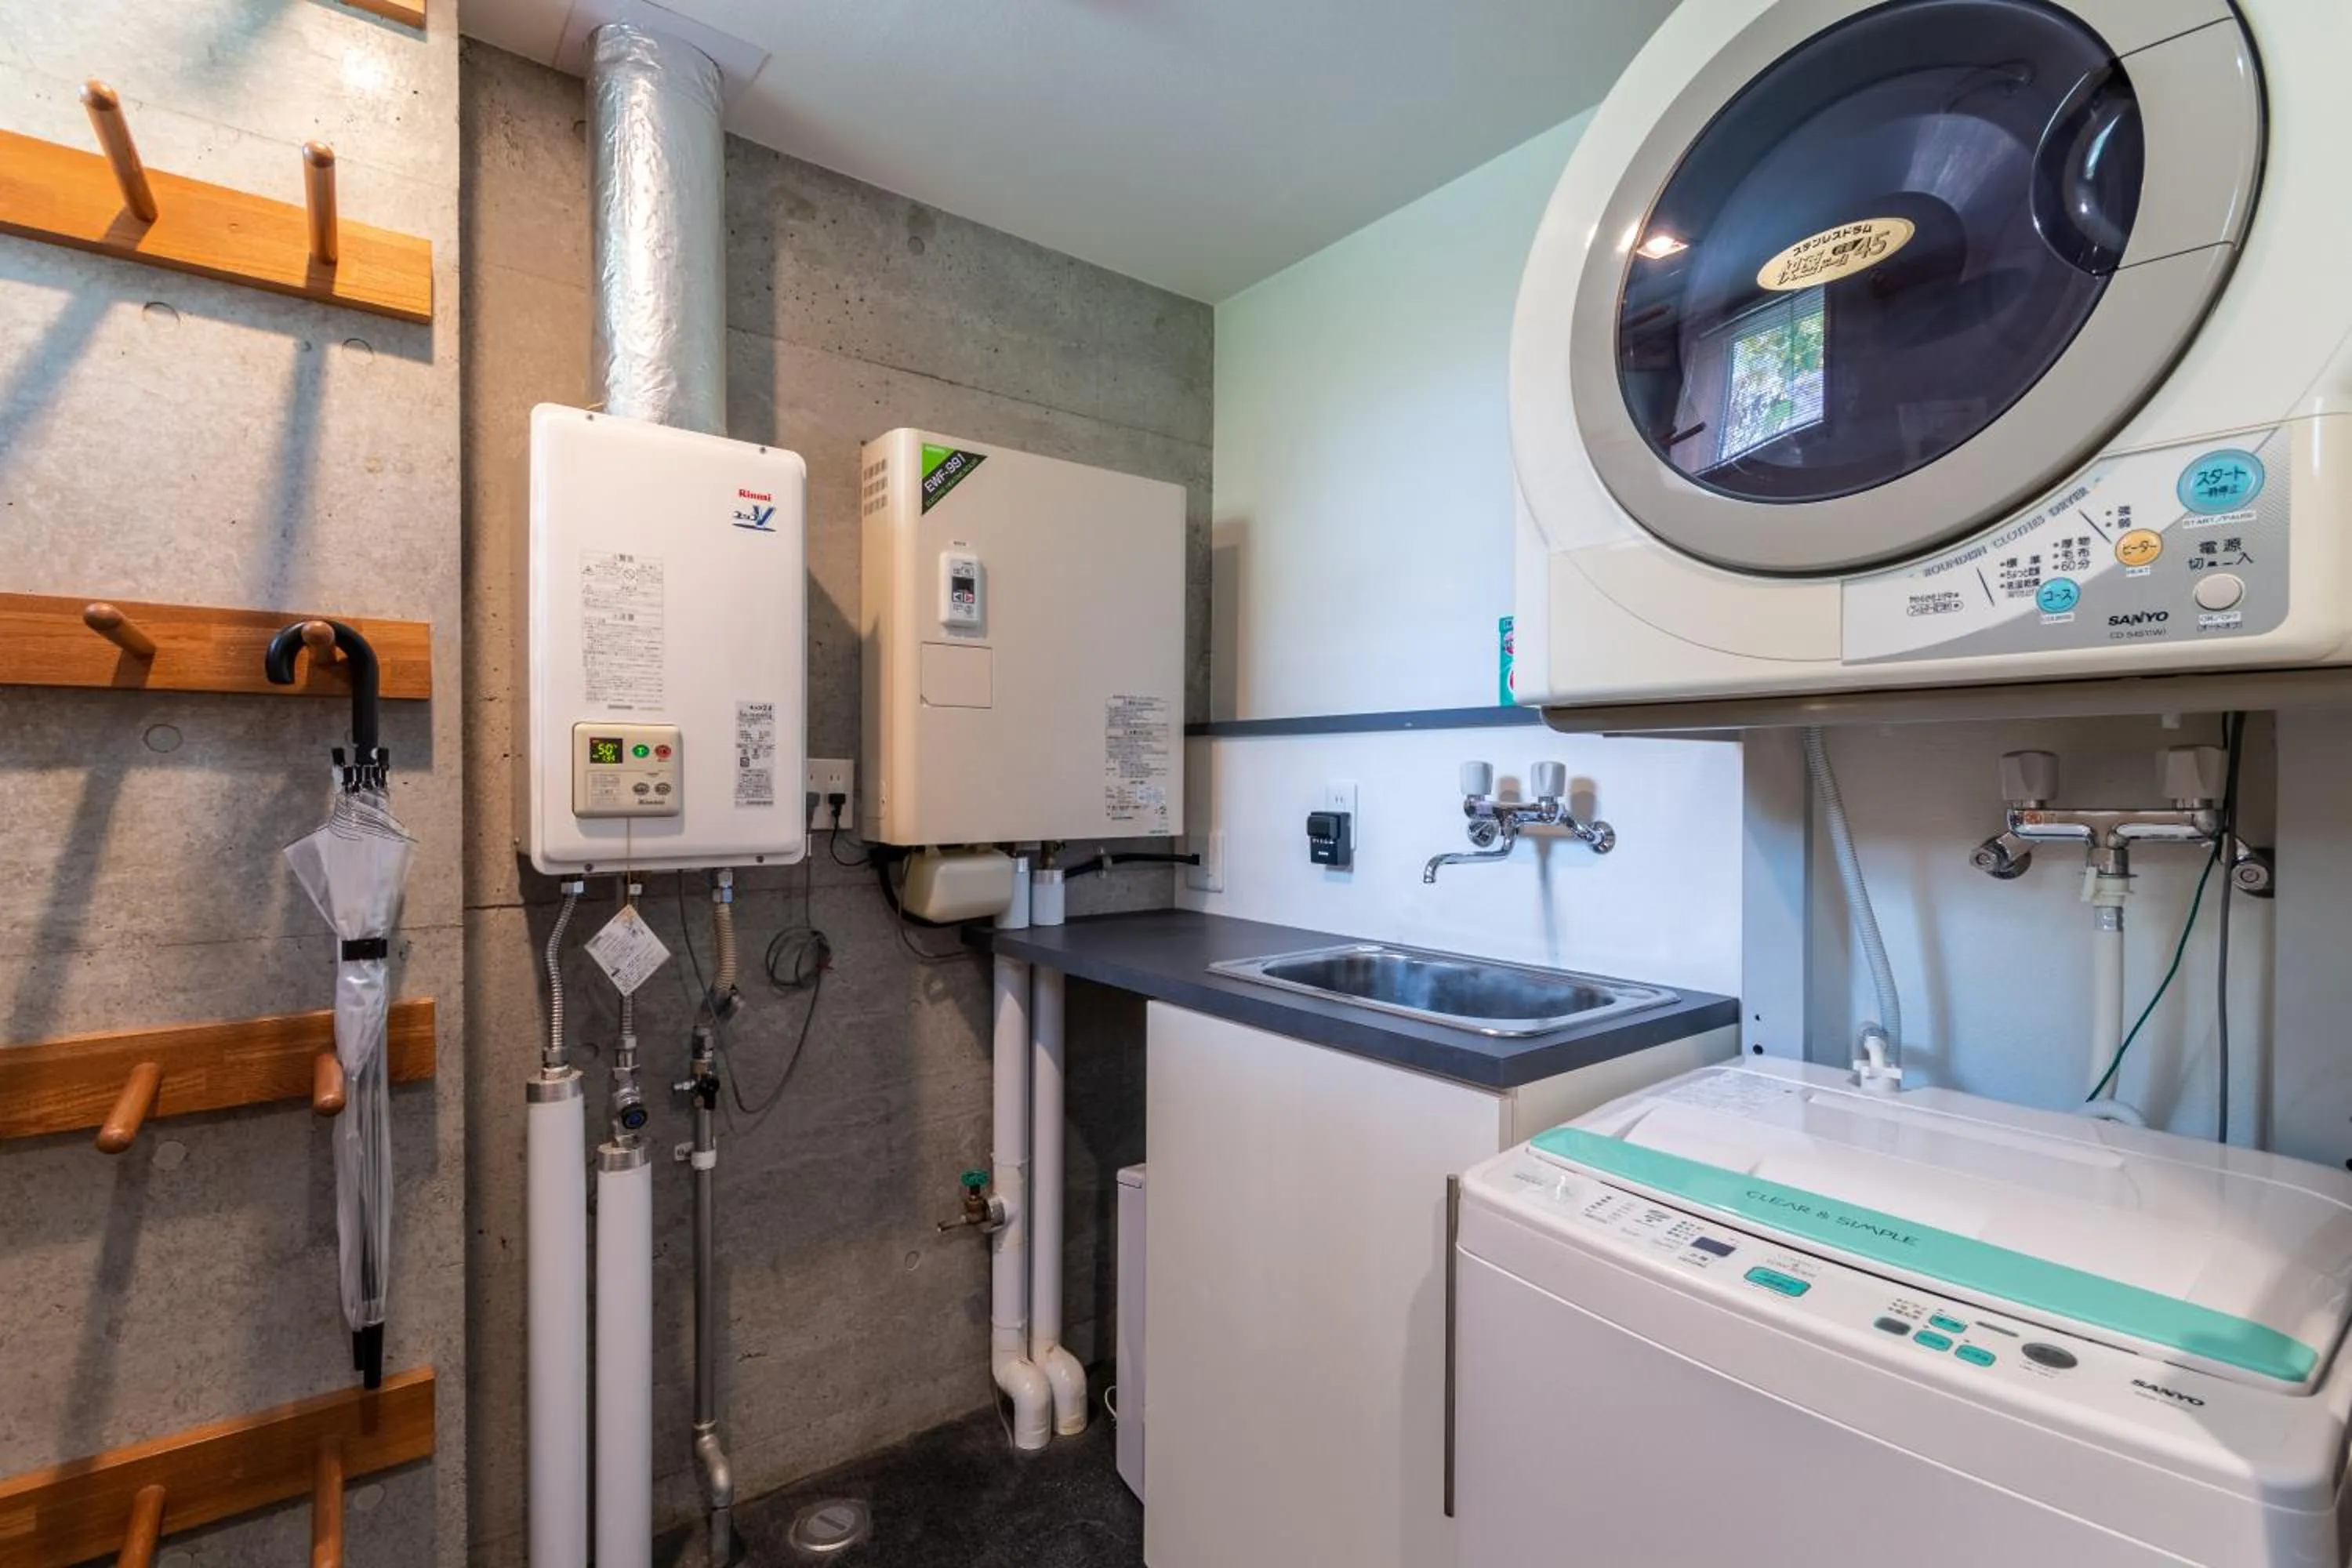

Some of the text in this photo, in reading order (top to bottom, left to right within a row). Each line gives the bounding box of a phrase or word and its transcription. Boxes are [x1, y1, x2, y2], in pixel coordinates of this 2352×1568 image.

[924, 452, 966, 492] EWF-991
[2196, 465, 2246, 487] スタート
[2043, 589, 2073, 603] コース
[2108, 611, 2169, 626] SANYO
[1746, 1189, 1811, 1214] CLEAR
[1835, 1215, 1920, 1247] SIMPLE
[2130, 1378, 2205, 1406] SANYO
